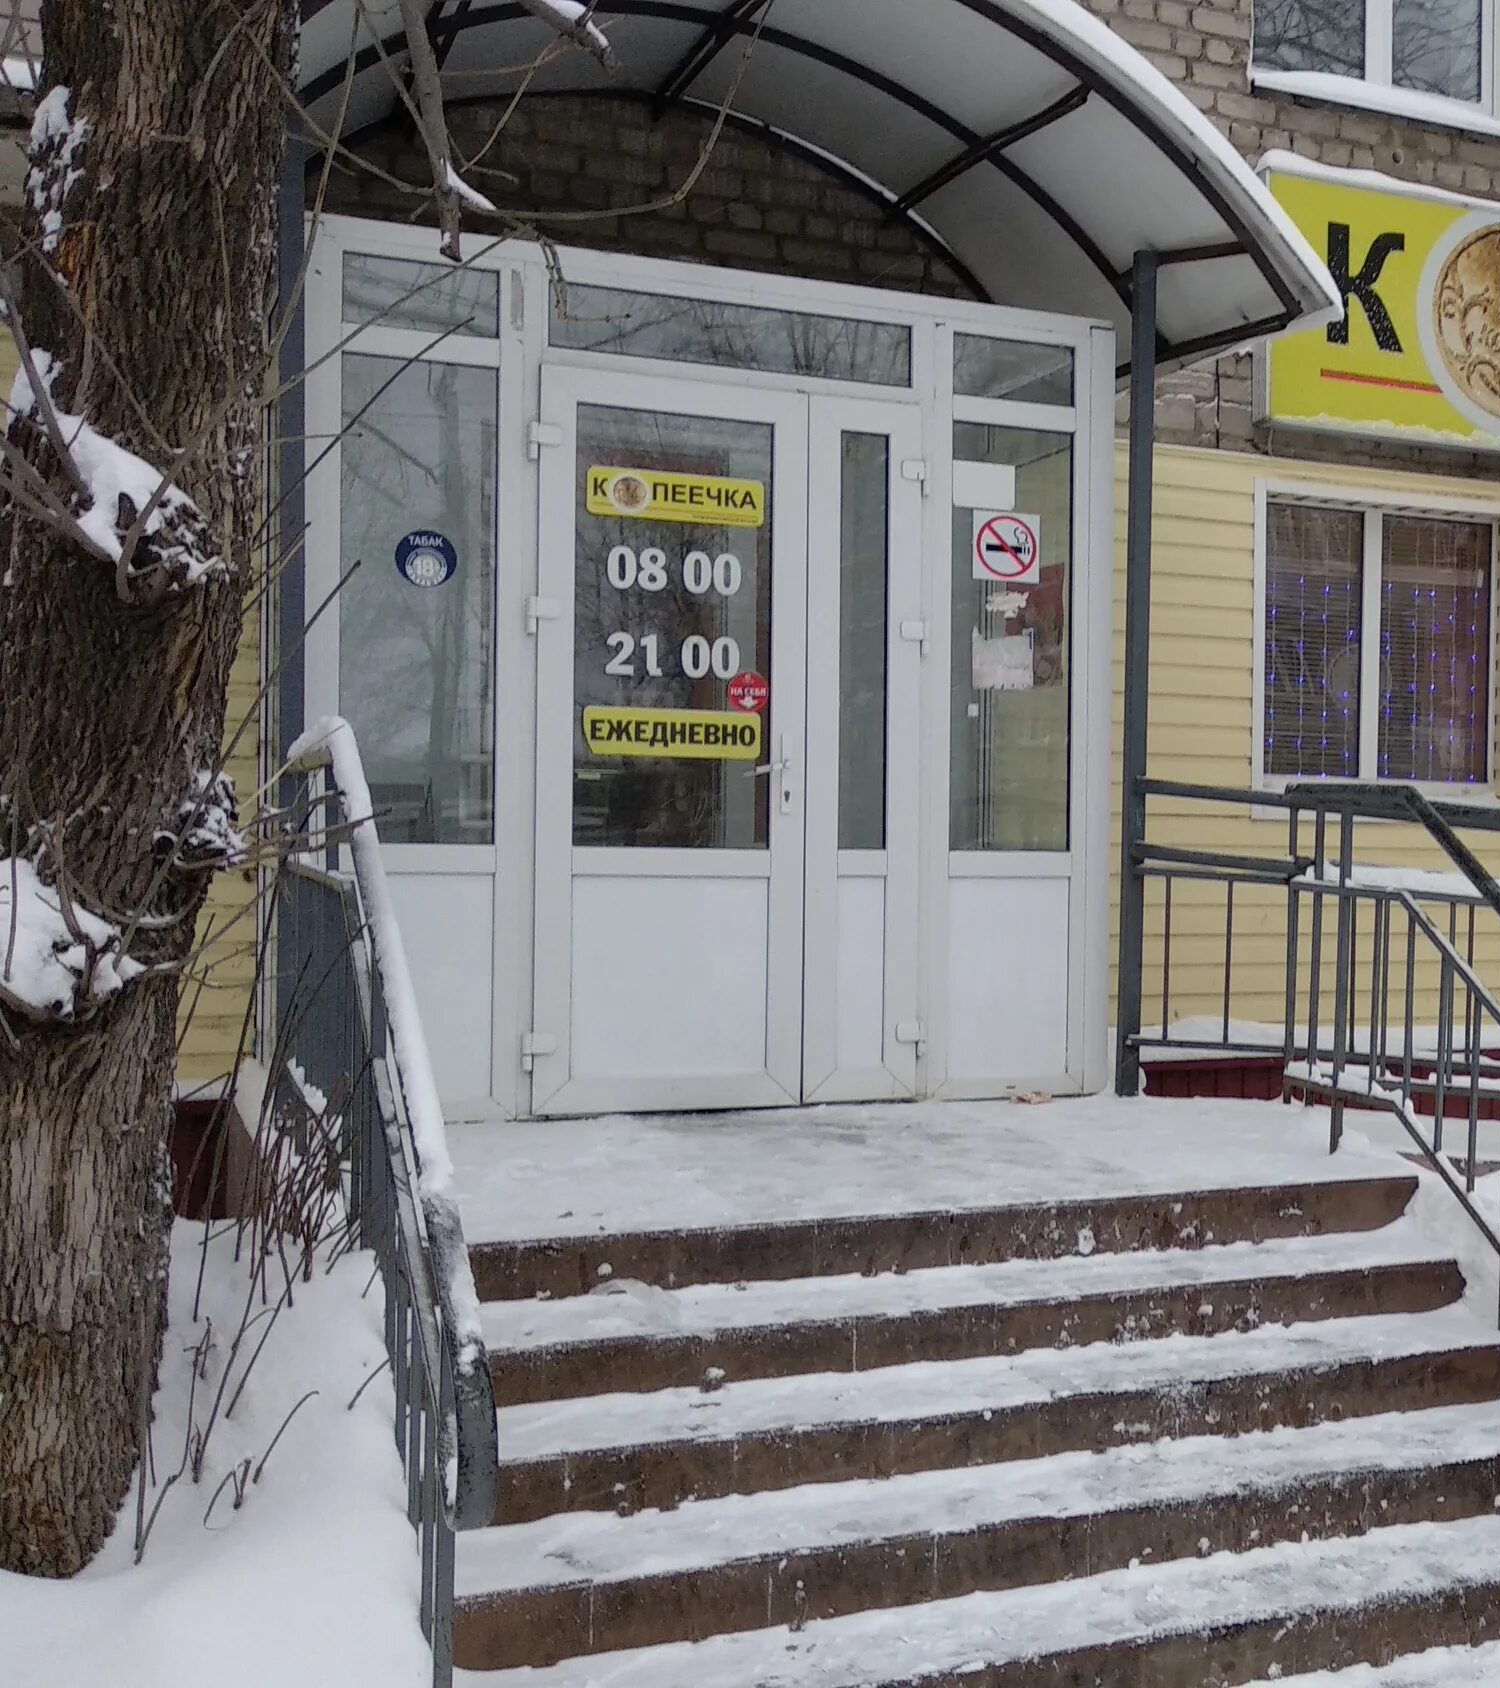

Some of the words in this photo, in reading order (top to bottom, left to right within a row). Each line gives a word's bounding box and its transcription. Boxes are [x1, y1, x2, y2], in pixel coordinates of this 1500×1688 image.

[408, 535, 445, 549] ТАБАК
[606, 545, 668, 592] 08
[682, 550, 742, 596] 00
[605, 631, 664, 678] 21
[681, 634, 740, 680] 00
[730, 686, 743, 697] НА
[744, 686, 767, 698] СЕБЯ
[590, 718, 756, 748] ЕЖЕДНЕВНО
